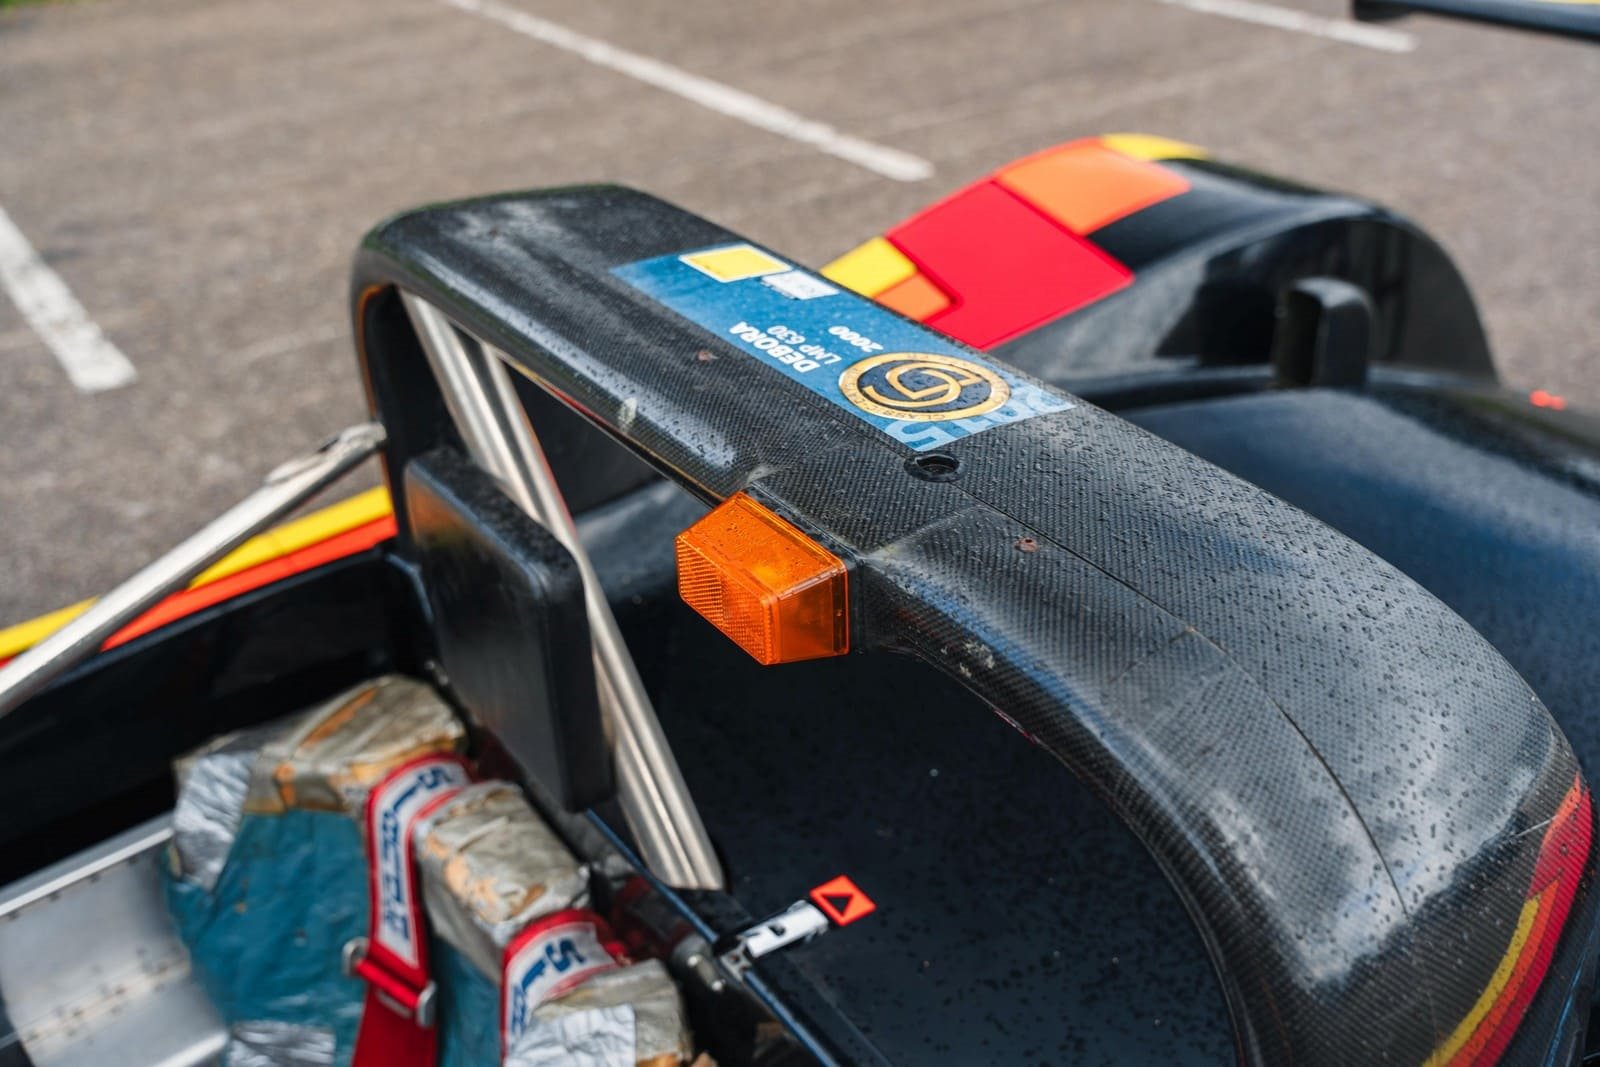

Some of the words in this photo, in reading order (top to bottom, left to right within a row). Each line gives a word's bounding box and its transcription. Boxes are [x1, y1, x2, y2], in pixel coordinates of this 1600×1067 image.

[729, 321, 821, 373] DEBORA
[766, 325, 806, 345] 630
[828, 325, 884, 353] 2000
[799, 344, 842, 365] LMP
